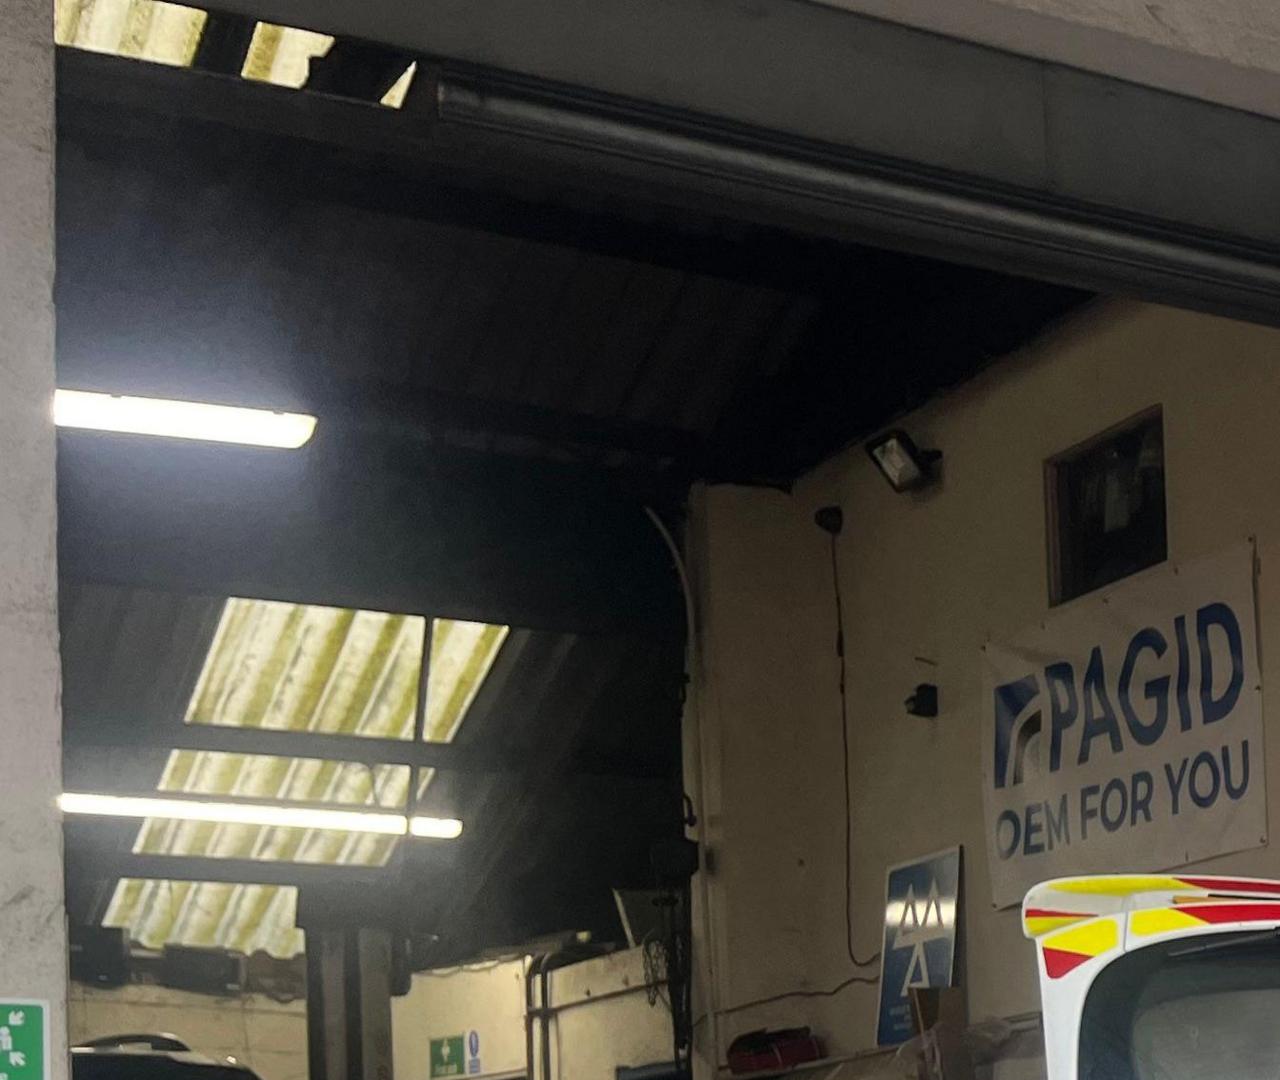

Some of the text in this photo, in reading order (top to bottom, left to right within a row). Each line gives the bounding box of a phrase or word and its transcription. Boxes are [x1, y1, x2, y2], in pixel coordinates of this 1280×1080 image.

[1044, 602, 1244, 773] PAGID
[996, 739, 1249, 860] OEM FOR YOU
